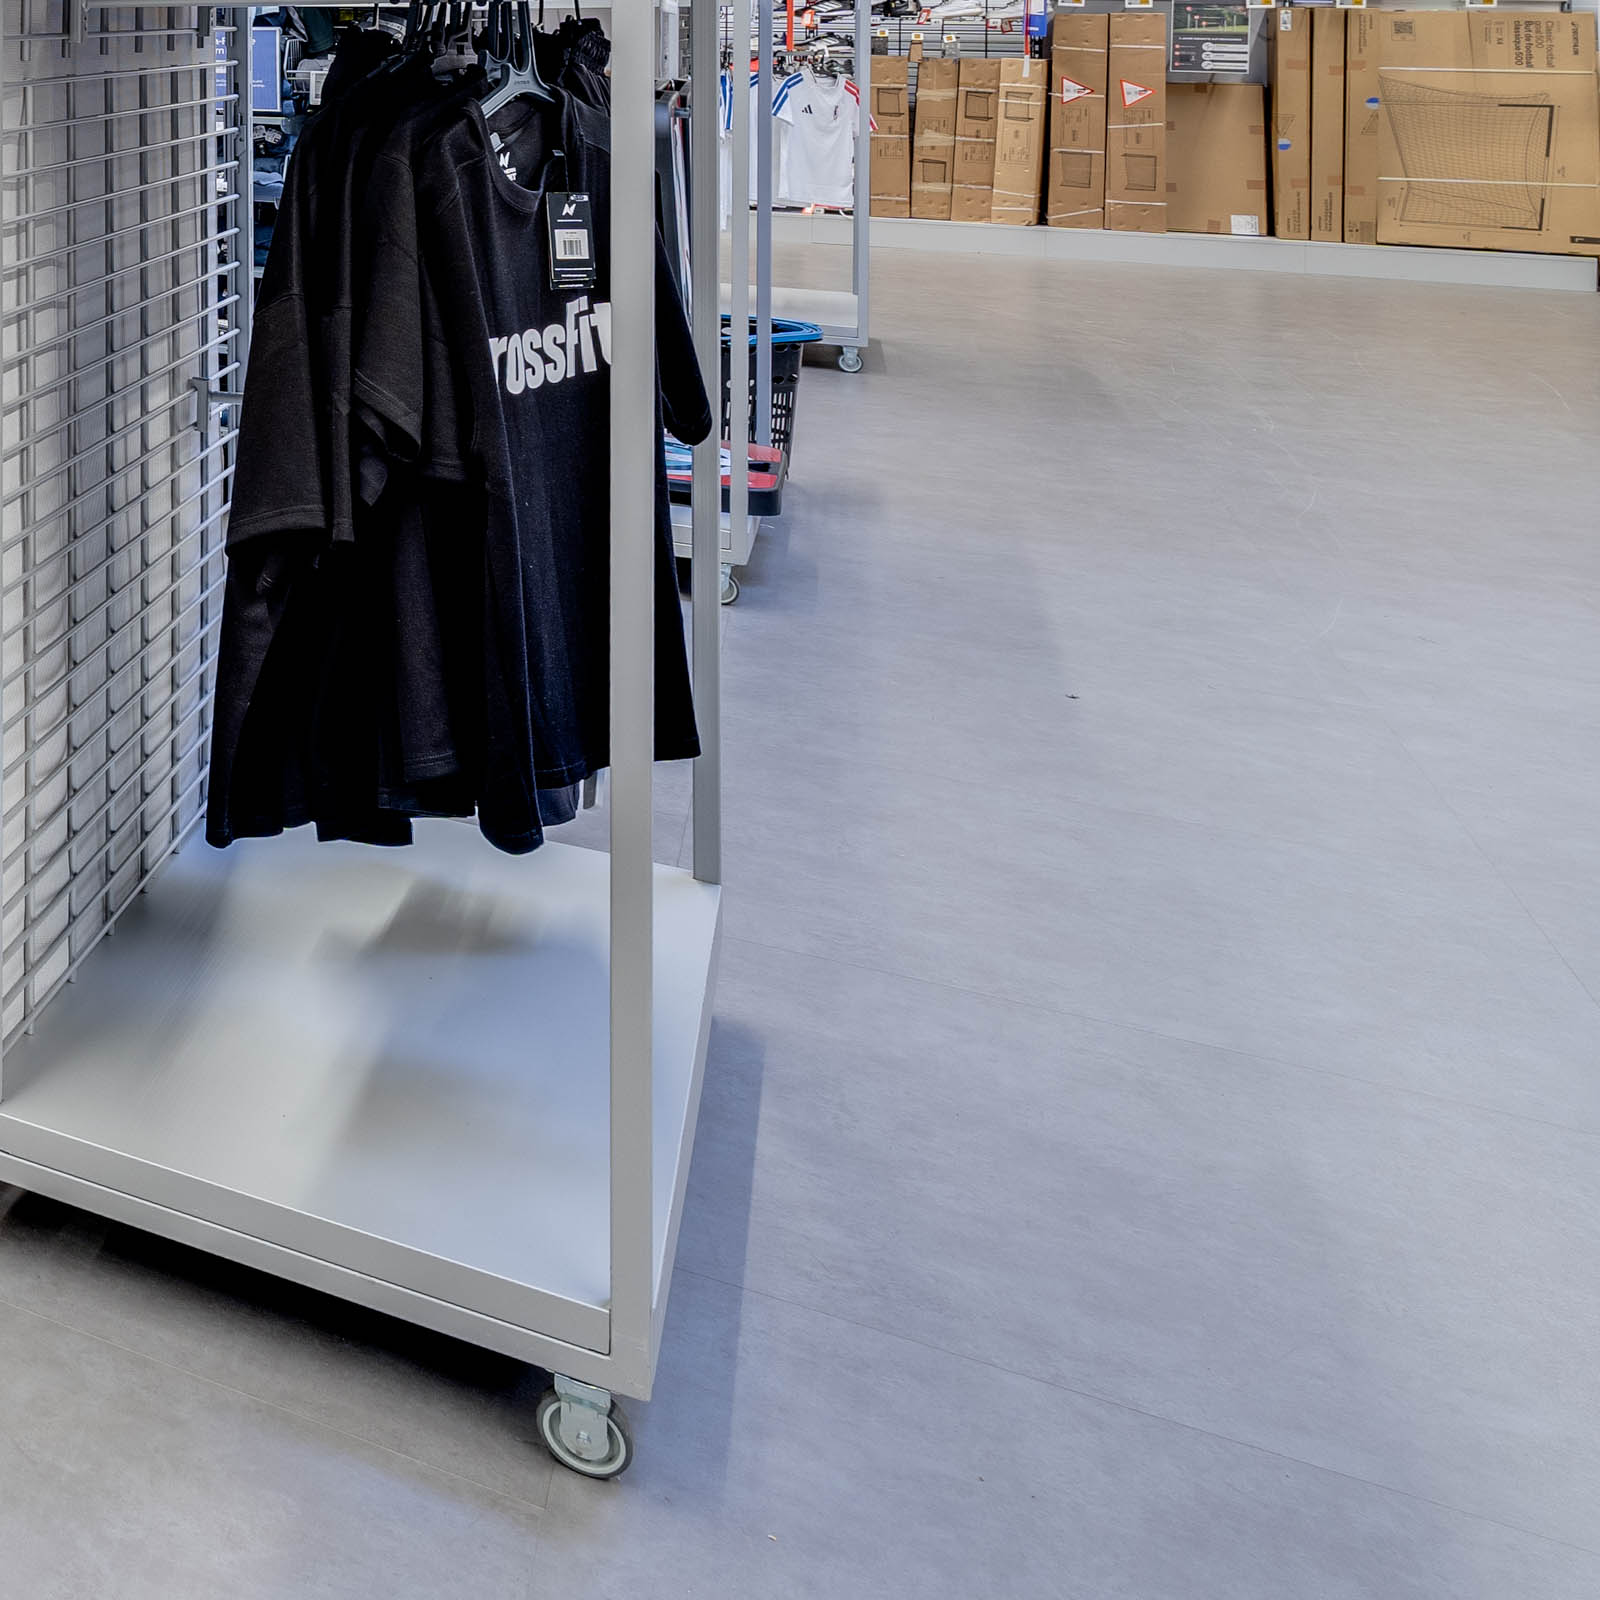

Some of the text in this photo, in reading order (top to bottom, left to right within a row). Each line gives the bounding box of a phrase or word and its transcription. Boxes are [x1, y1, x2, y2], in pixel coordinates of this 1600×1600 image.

[1512, 20, 1524, 66] classique 500
[1524, 20, 1535, 69] But de football
